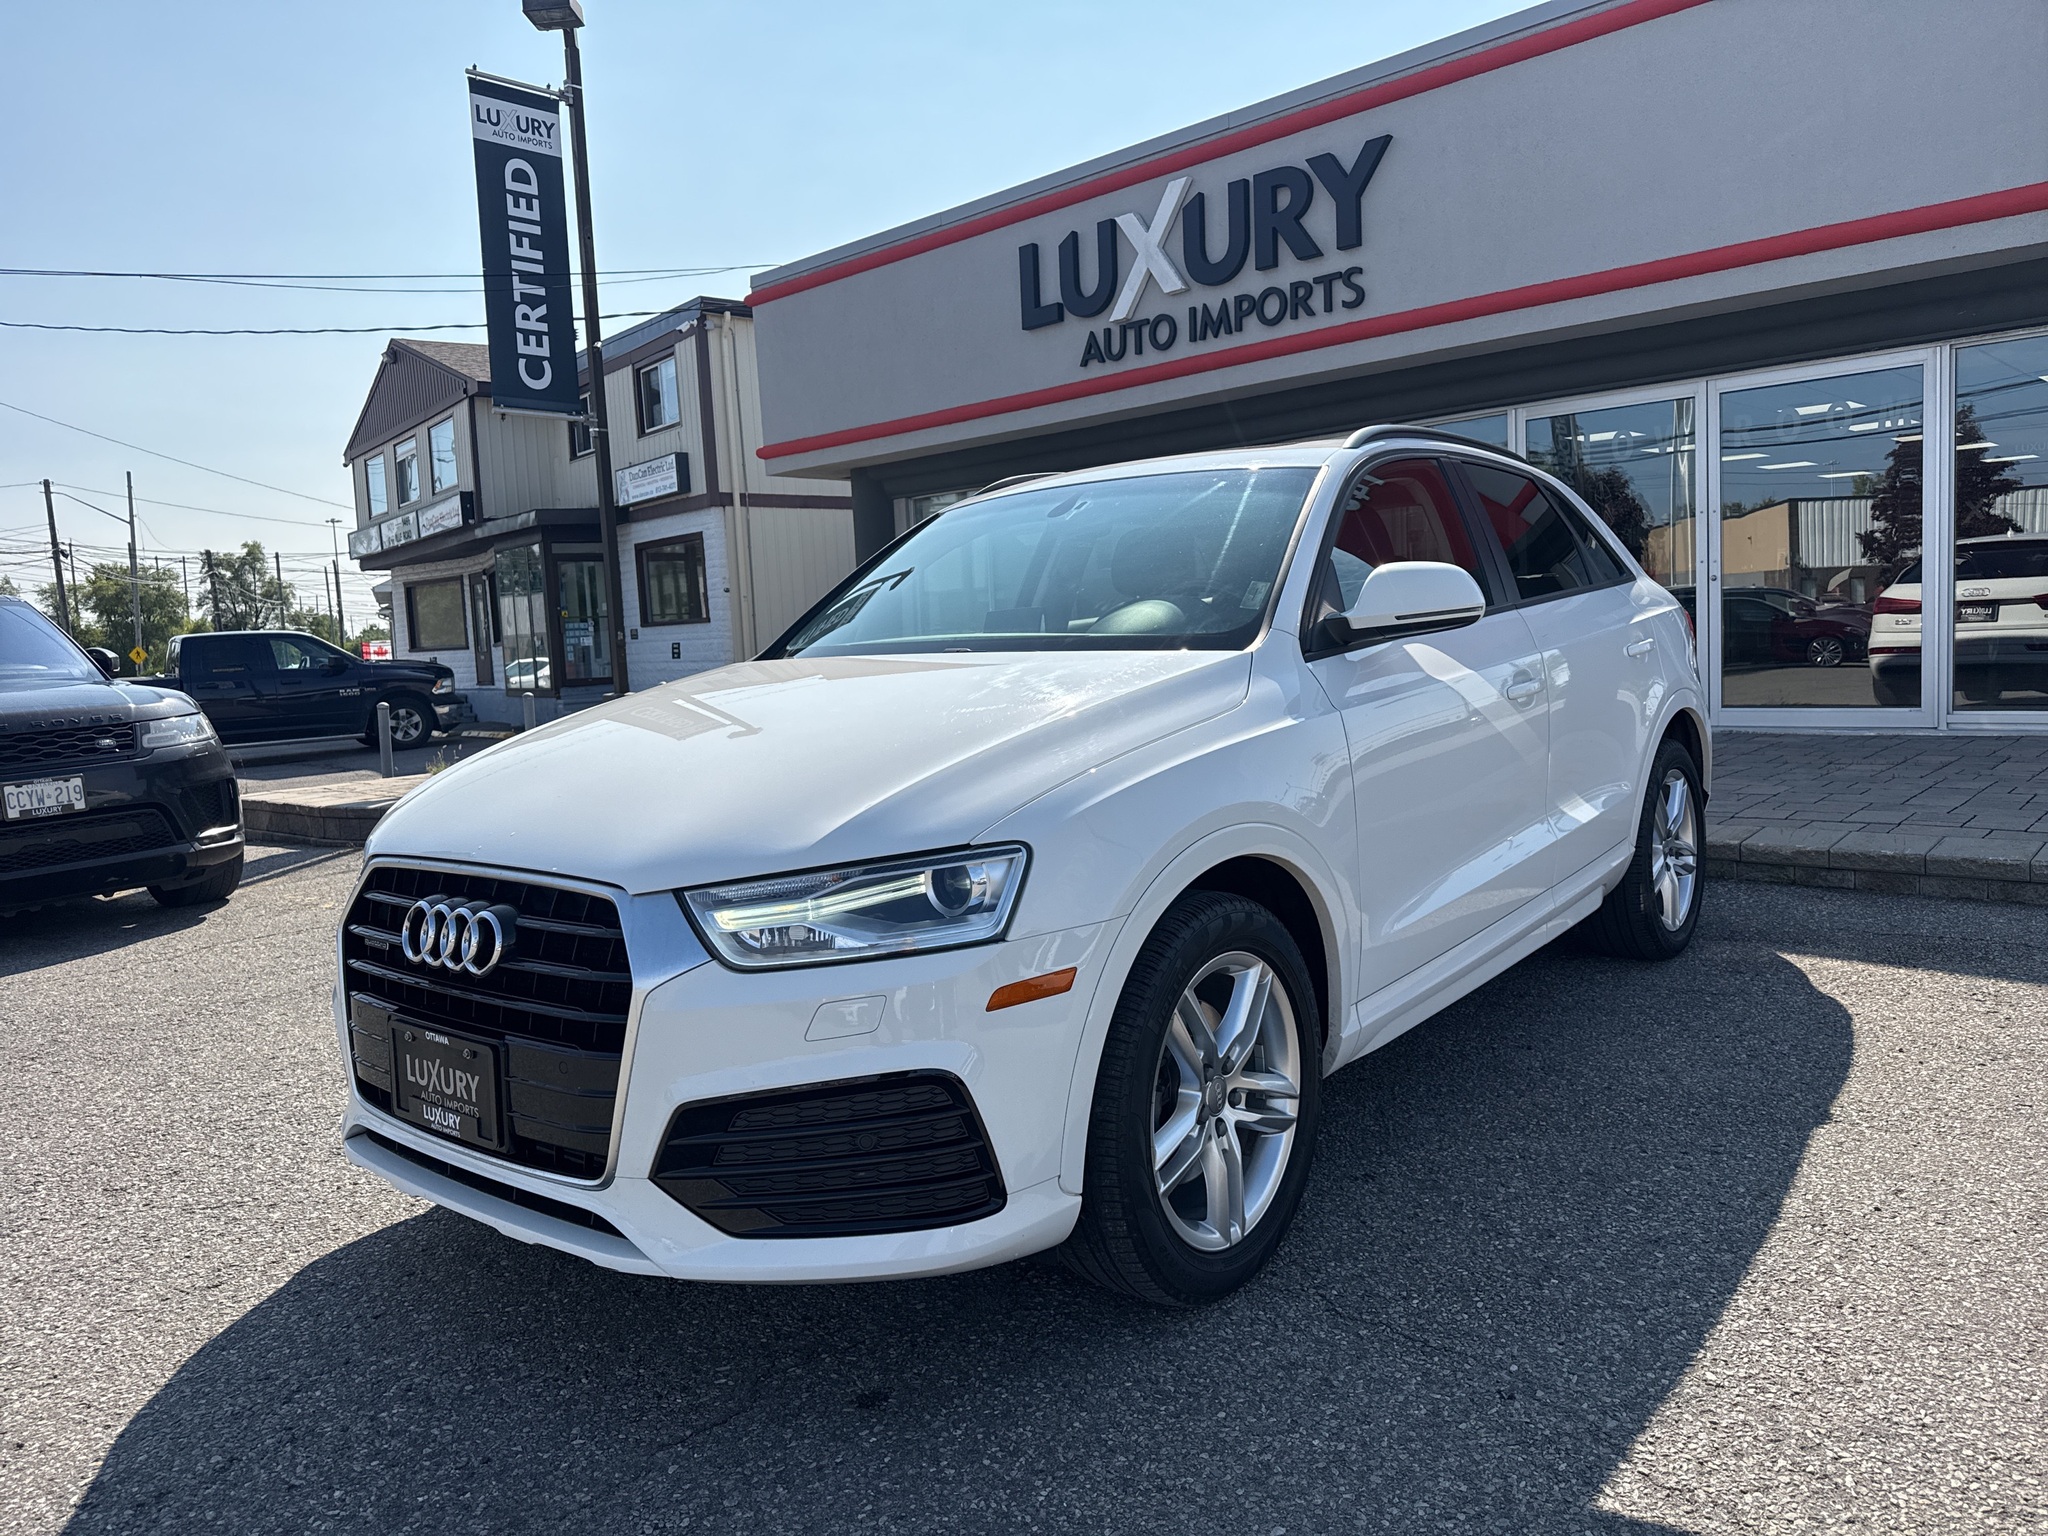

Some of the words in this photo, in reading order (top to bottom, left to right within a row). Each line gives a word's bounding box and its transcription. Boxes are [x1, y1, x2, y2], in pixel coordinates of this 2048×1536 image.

[475, 104, 555, 139] LUXURY
[492, 130, 515, 141] AUTO
[517, 136, 552, 149] IMPORTS
[1018, 133, 1393, 330] LUXURY
[504, 158, 552, 390] CERTIFIED
[1079, 313, 1177, 367] AUTO
[1189, 266, 1365, 342] IMPORTS
[2015, 441, 2048, 454] LUXU
[30, 713, 125, 727] ROVER
[7, 788, 46, 810] CCYW
[54, 784, 83, 804] 219
[32, 805, 63, 815] LUXURY
[425, 1031, 450, 1046] OTTAWA
[405, 1054, 480, 1103] LUXURY
[420, 1091, 442, 1105] AUTO
[444, 1097, 480, 1118] IMPORTS
[423, 1104, 461, 1130] LUXURY
[431, 1123, 442, 1131] AUTO
[442, 1127, 461, 1138] IMPORTS
